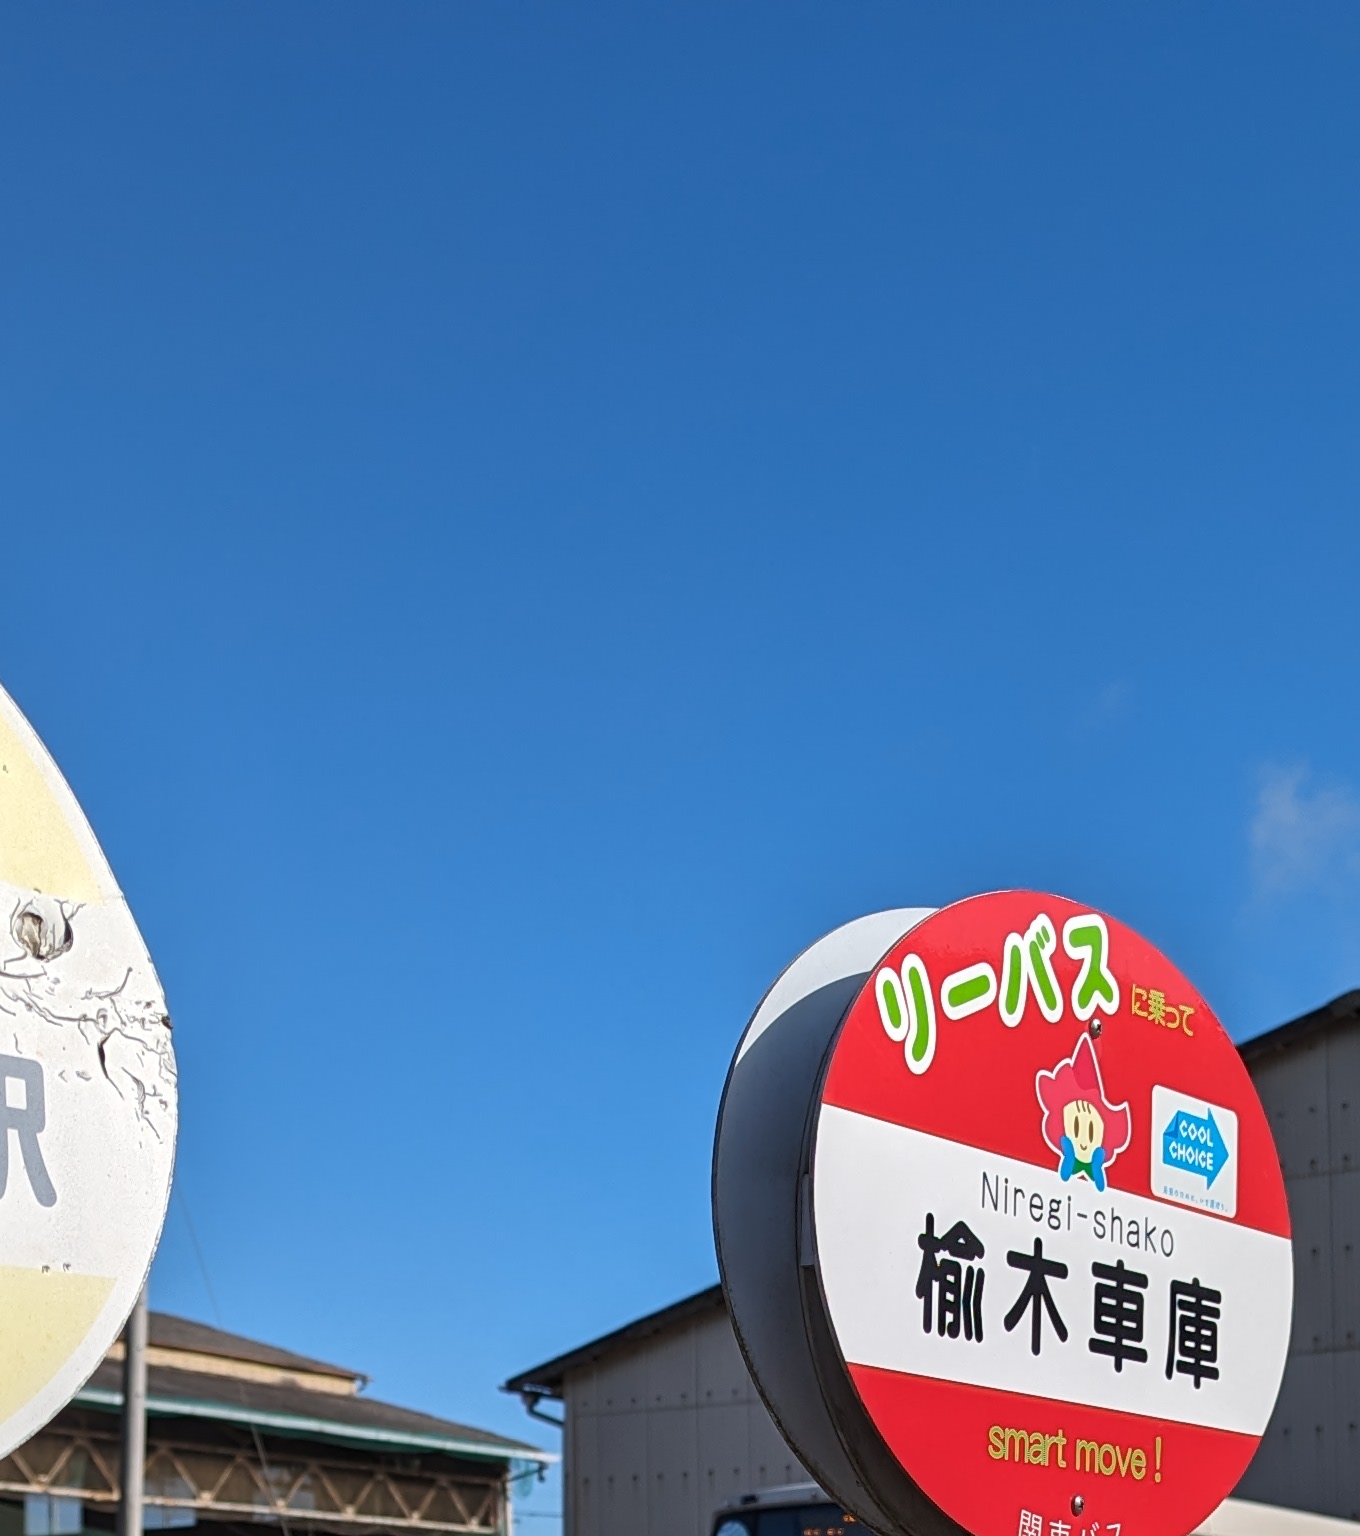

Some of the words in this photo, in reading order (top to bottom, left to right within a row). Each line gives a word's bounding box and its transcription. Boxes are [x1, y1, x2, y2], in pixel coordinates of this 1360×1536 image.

[875, 913, 1120, 1075] リーバス
[1132, 984, 1195, 1036] に乗って
[1168, 1140, 1214, 1172] CHOICE
[1179, 1119, 1214, 1148] COOL
[981, 1171, 1175, 1258] Niregi-shako
[914, 1212, 1222, 1389] 楡木車庫
[987, 1423, 1067, 1470] smart
